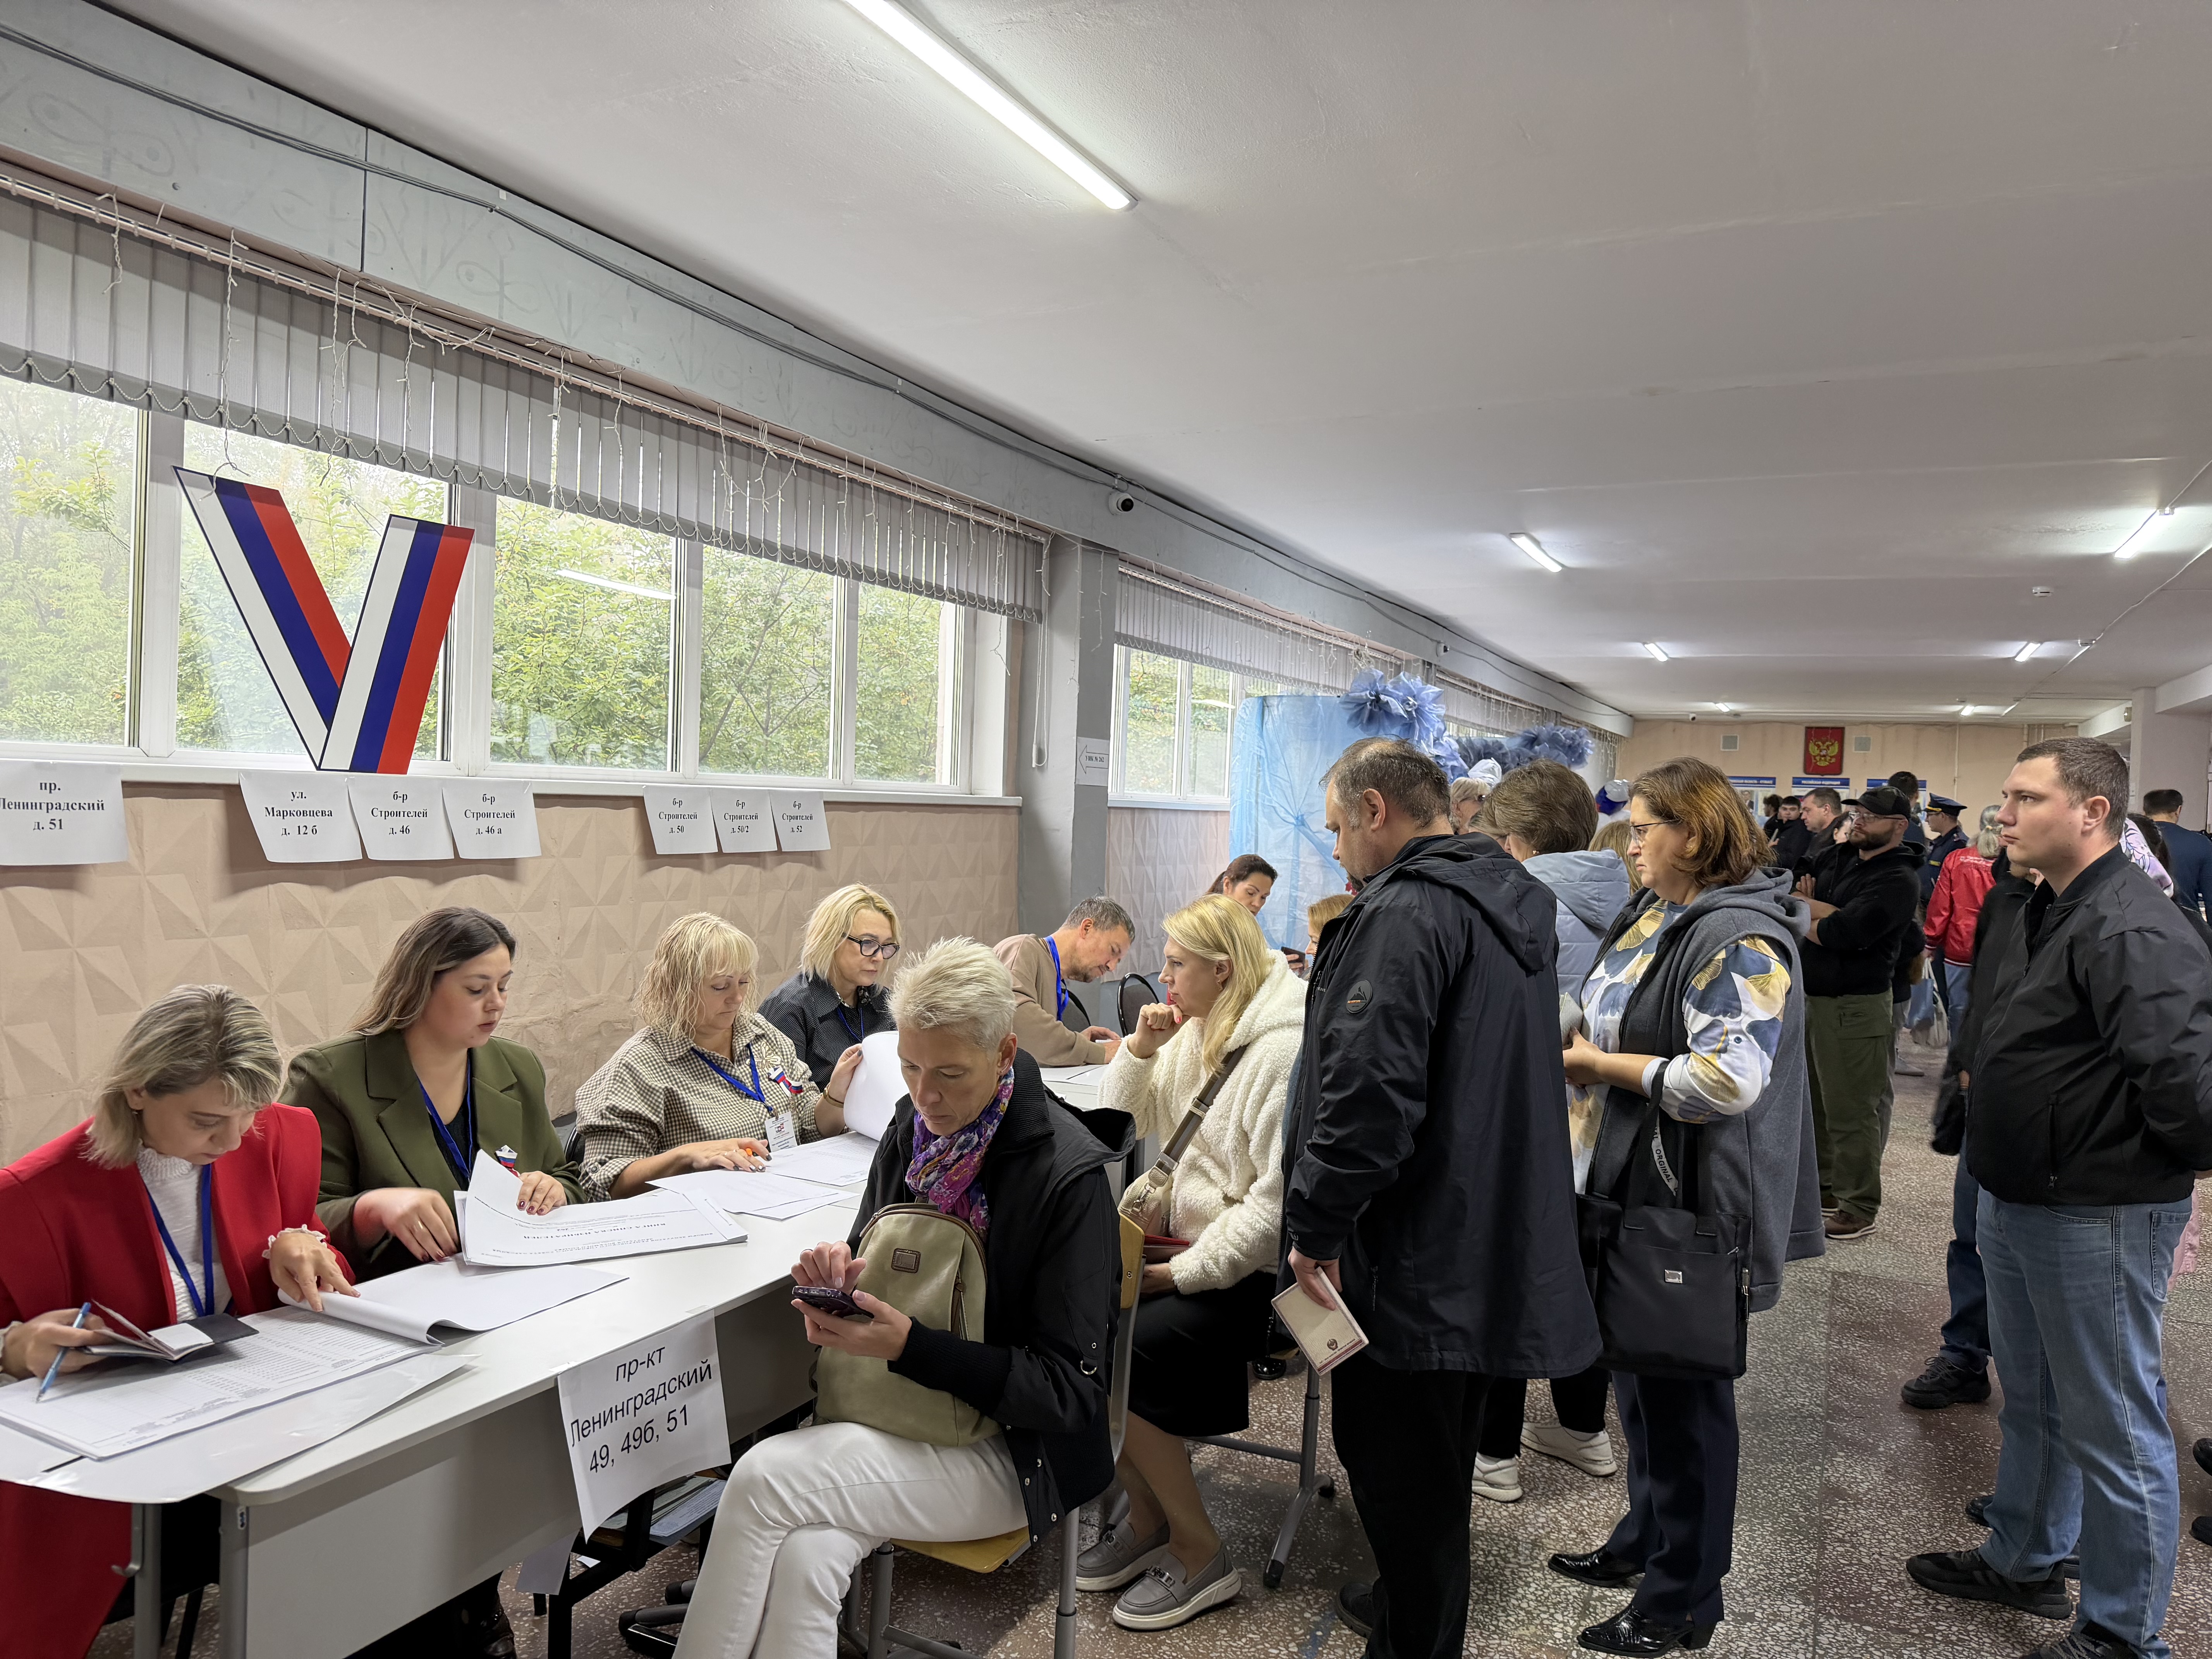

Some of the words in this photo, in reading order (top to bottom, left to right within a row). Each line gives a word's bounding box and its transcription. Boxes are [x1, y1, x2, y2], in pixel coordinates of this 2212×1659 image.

[40, 782, 61, 794] пр.
[291, 791, 307, 802] ул.
[393, 791, 408, 804] б-р
[482, 793, 496, 805] б-р
[0, 797, 105, 814] Ленинградский
[672, 798, 683, 808] б-р
[736, 800, 745, 809] б-р
[793, 801, 802, 810] б-р
[264, 807, 333, 820] Марковцева
[371, 807, 428, 820] Строителей
[464, 809, 515, 821] Строителей
[658, 811, 697, 822] Строителей
[724, 813, 758, 822] Строителей
[782, 813, 813, 822] Строителей
[33, 821, 45, 831] д.
[49, 818, 64, 830] 51
[389, 827, 397, 835] д.
[399, 825, 410, 835] 46
[485, 825, 495, 835] 46
[677, 825, 685, 833] 50
[737, 825, 749, 833] 50/2
[281, 828, 290, 836] д.
[297, 825, 308, 835] 12
[1656, 1149, 1673, 1182] ORGINAL
[615, 1346, 665, 1382] пр-кт
[570, 1358, 712, 1448] Ленинградский
[589, 1444, 615, 1473] 49,
[666, 1404, 688, 1432] 51
